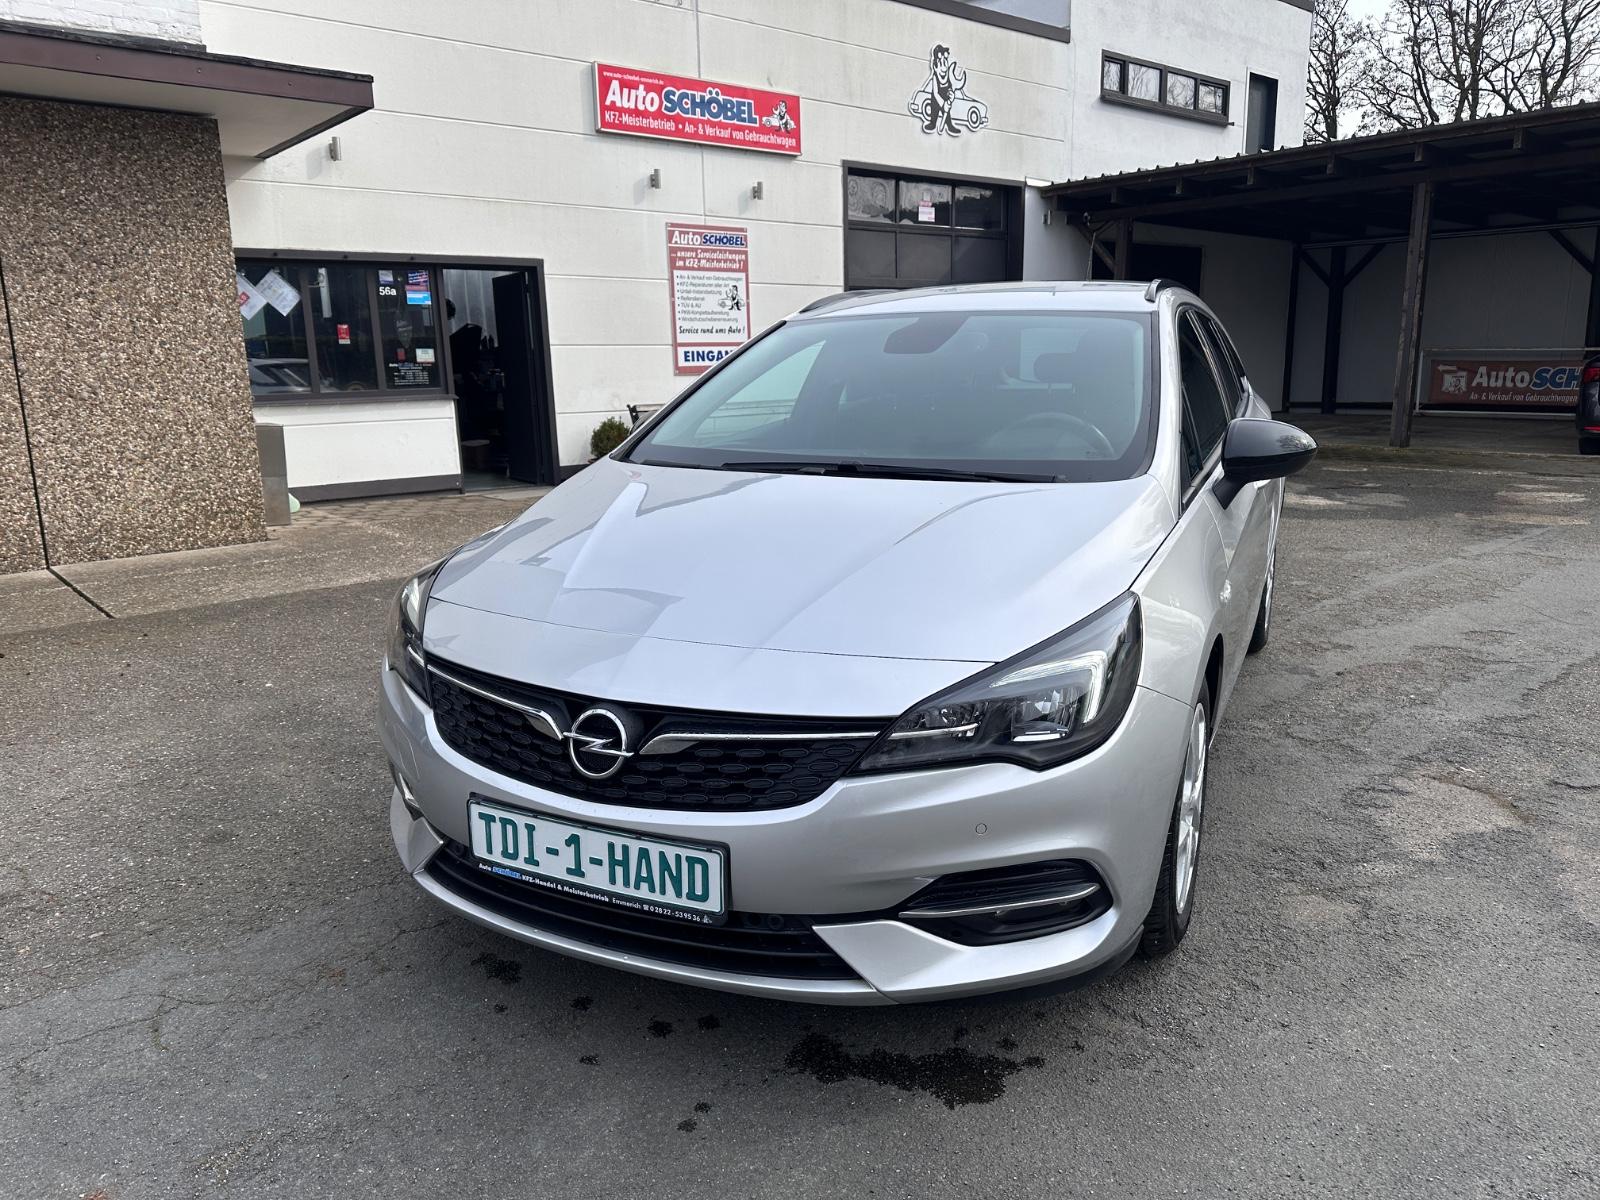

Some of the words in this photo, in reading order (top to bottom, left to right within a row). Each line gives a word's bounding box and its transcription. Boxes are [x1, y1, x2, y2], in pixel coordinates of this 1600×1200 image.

[605, 80, 660, 112] Auto
[662, 87, 758, 126] SCHÖBEL
[605, 110, 676, 131] KFZ-Meisterbetrieb
[684, 121, 697, 133] An-
[698, 123, 704, 134] &
[705, 124, 731, 138] Verkauf
[732, 130, 744, 140] von
[745, 130, 796, 148] Gebrauchtwagen
[672, 231, 700, 245] Auto
[702, 232, 745, 247] SCHÖBEL
[676, 258, 684, 267] im
[697, 250, 746, 261] Serviceleistungen
[379, 287, 397, 296] 56a
[679, 325, 699, 334] Service
[701, 325, 713, 334] rund
[728, 326, 741, 334] Auto
[1471, 366, 1530, 387] Auto
[1481, 392, 1486, 400] &
[1488, 391, 1512, 400] Verkauf
[1525, 392, 1578, 403] Gebrauchtwagen
[563, 885, 609, 902] Meisterbetrieb
[612, 897, 641, 909] Emmerich
